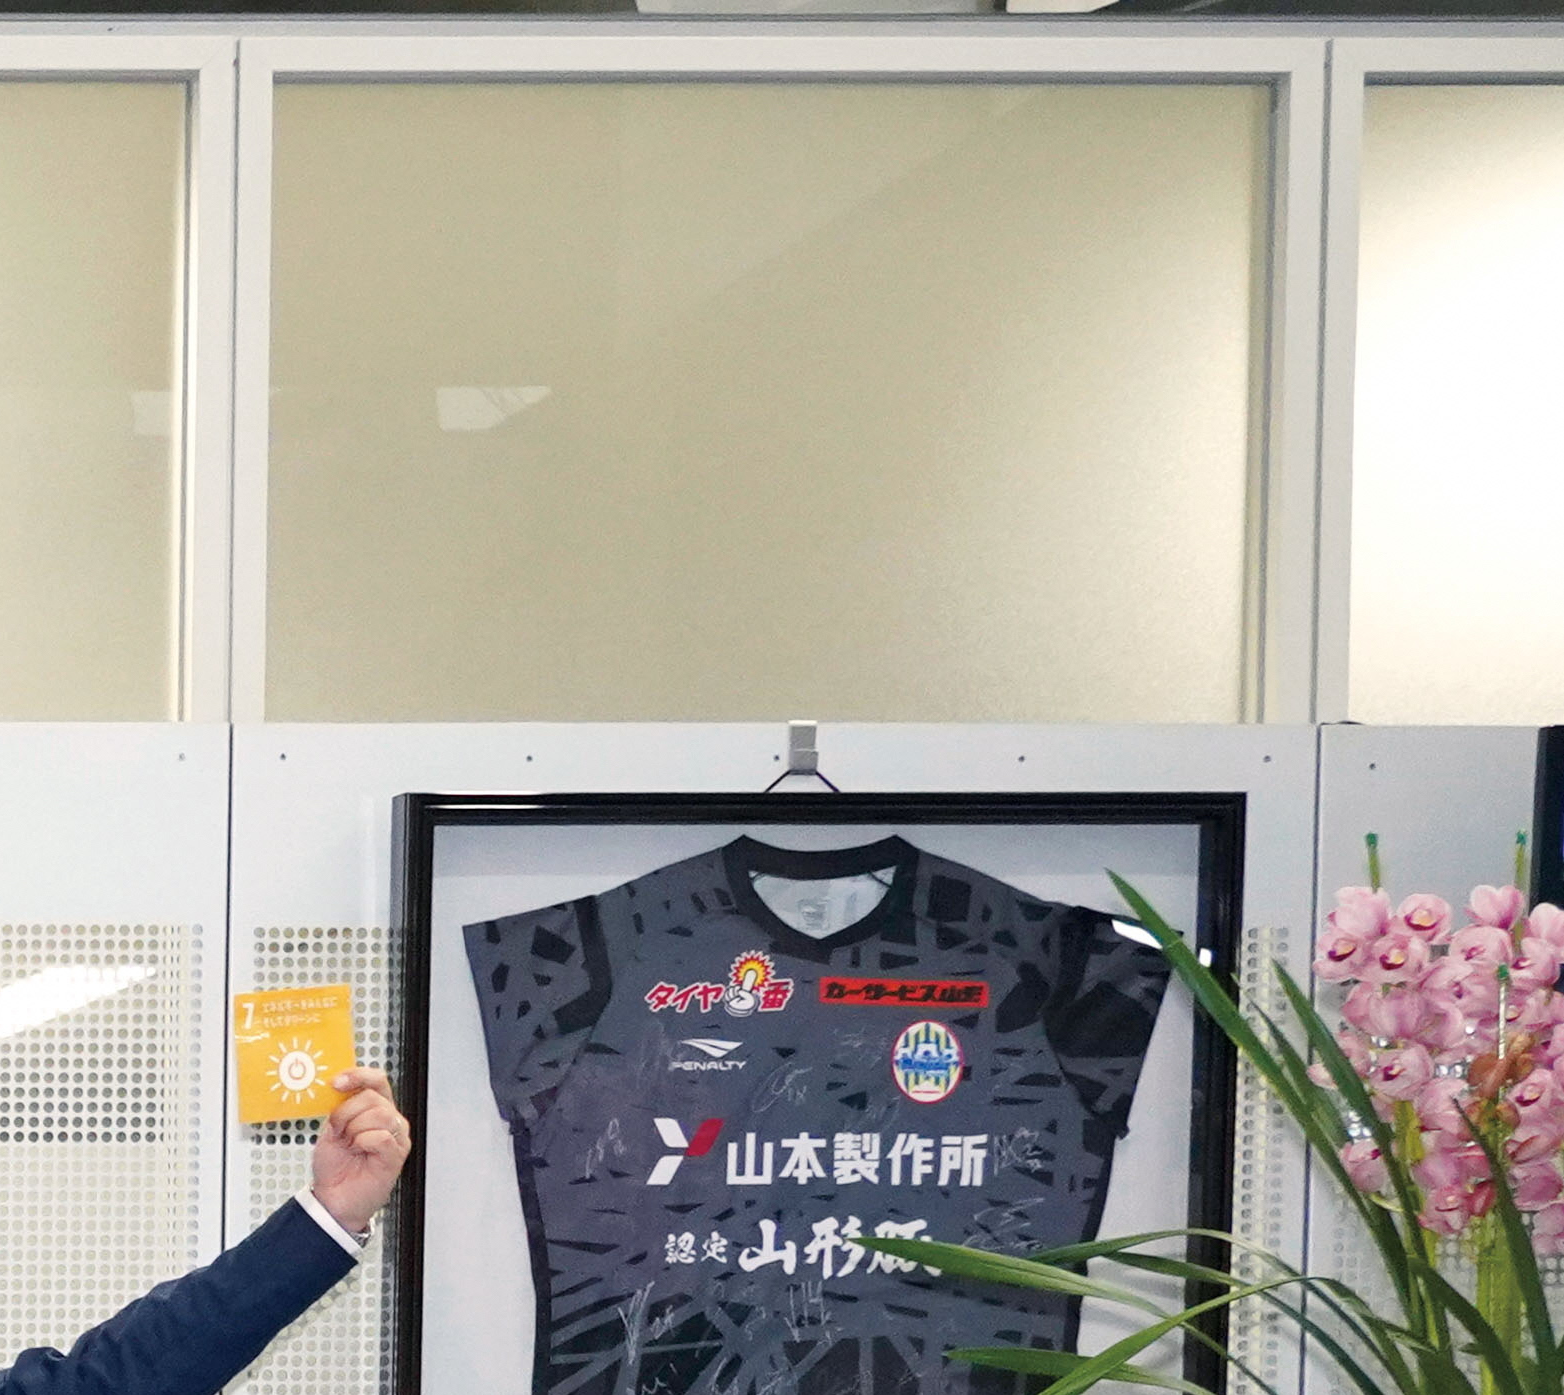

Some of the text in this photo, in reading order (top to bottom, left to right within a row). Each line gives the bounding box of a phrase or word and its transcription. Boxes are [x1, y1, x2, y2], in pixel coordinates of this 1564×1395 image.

[645, 981, 725, 1014] タイヤ
[241, 1002, 255, 1030] 7
[669, 1060, 747, 1071] PENALTY
[725, 1131, 989, 1187] 山本製作所
[664, 1231, 728, 1265] 認定
